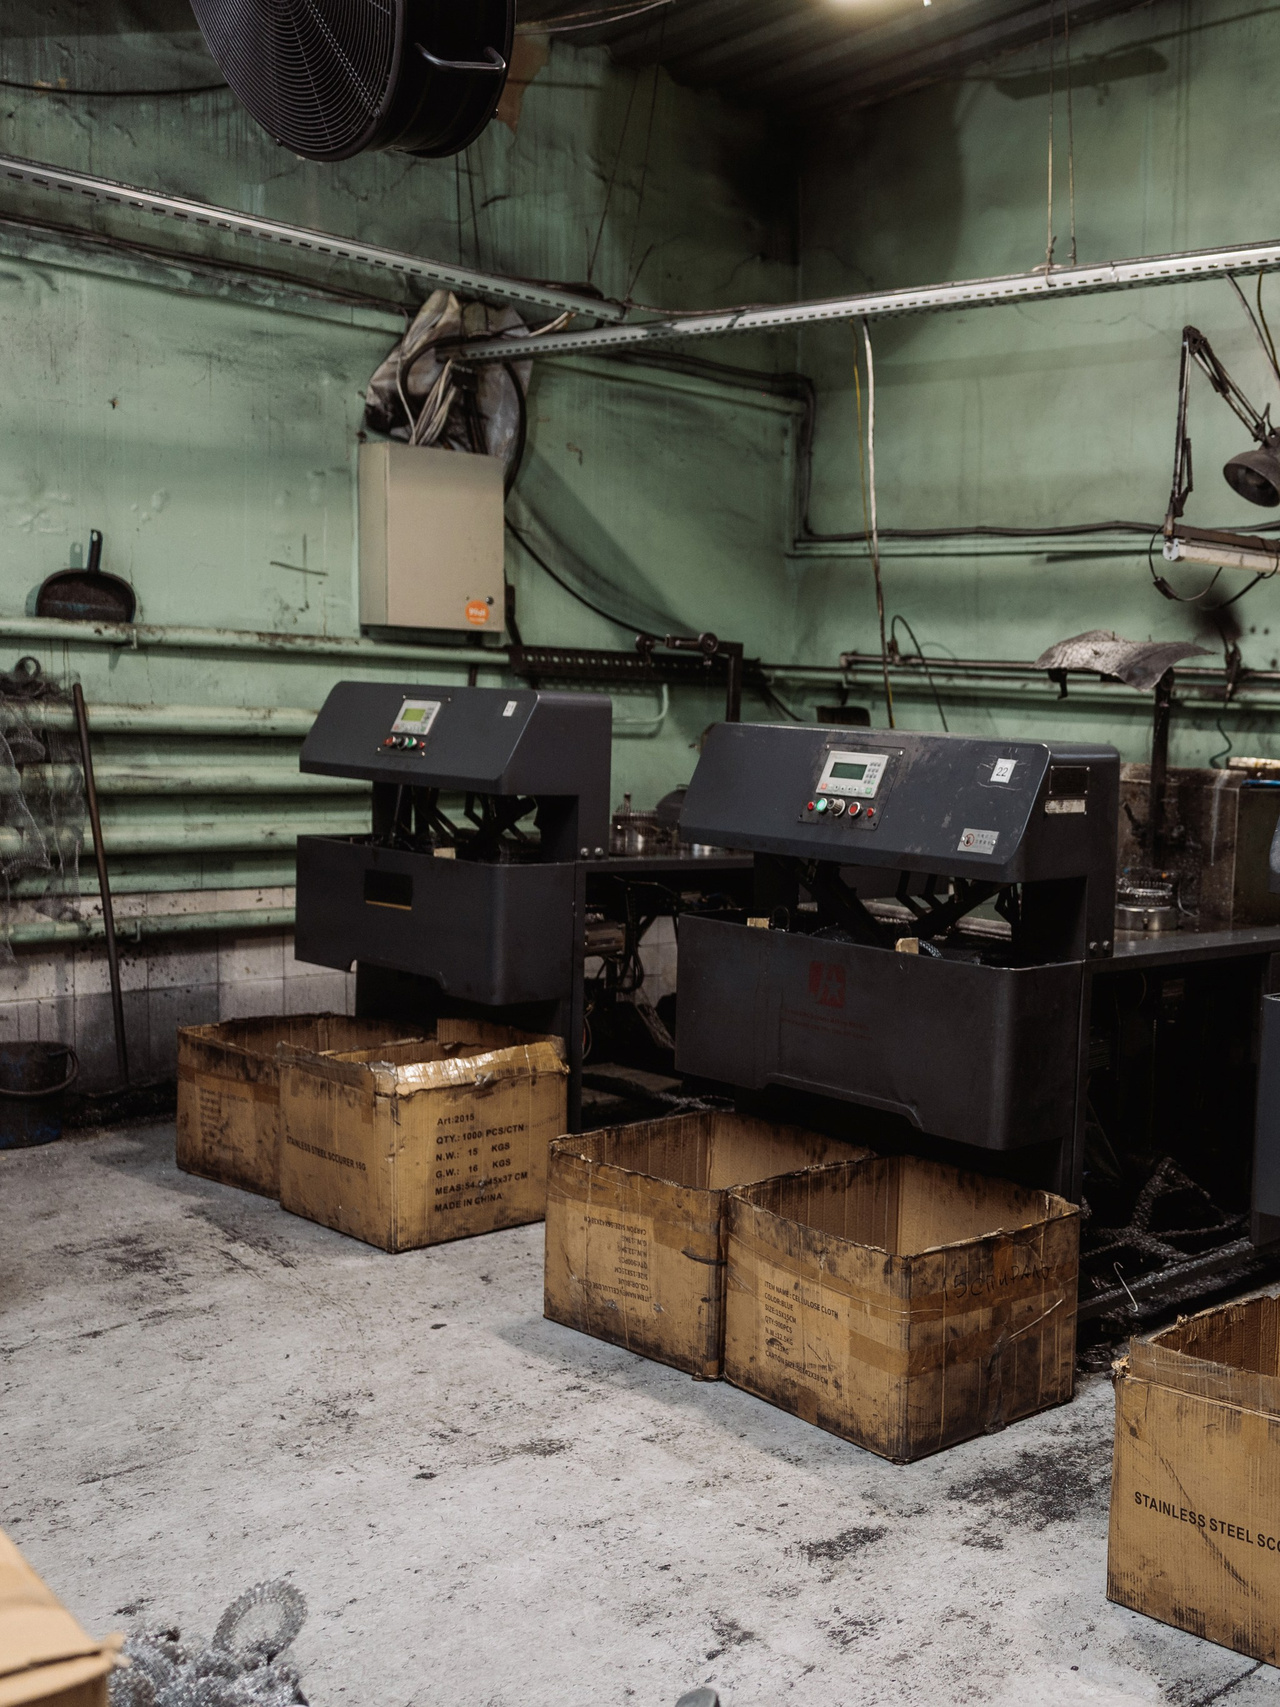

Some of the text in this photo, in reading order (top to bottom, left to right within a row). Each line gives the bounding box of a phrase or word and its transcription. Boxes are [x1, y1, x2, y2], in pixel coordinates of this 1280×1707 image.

[996, 766, 1009, 777] 22
[437, 1113, 475, 1125] Art:2015
[436, 1123, 525, 1145] QTY.: 1000 PCS/CTN
[468, 1148, 478, 1156] 15
[491, 1142, 511, 1153] KGS
[435, 1158, 511, 1179] G.W.: 16 KGS
[514, 1171, 528, 1181] CM
[434, 1193, 503, 1212] MADE IN CHINA
[765, 1293, 793, 1311] COLOR:BLUE
[792, 1294, 820, 1311] CELLULOSE
[821, 1305, 838, 1319] CLOTH
[765, 1304, 797, 1324] SIZE:15X15CM
[765, 1315, 792, 1333] QTY:900PCS
[1134, 1491, 1206, 1527] STAINLESS
[1209, 1518, 1253, 1544] STEEL
